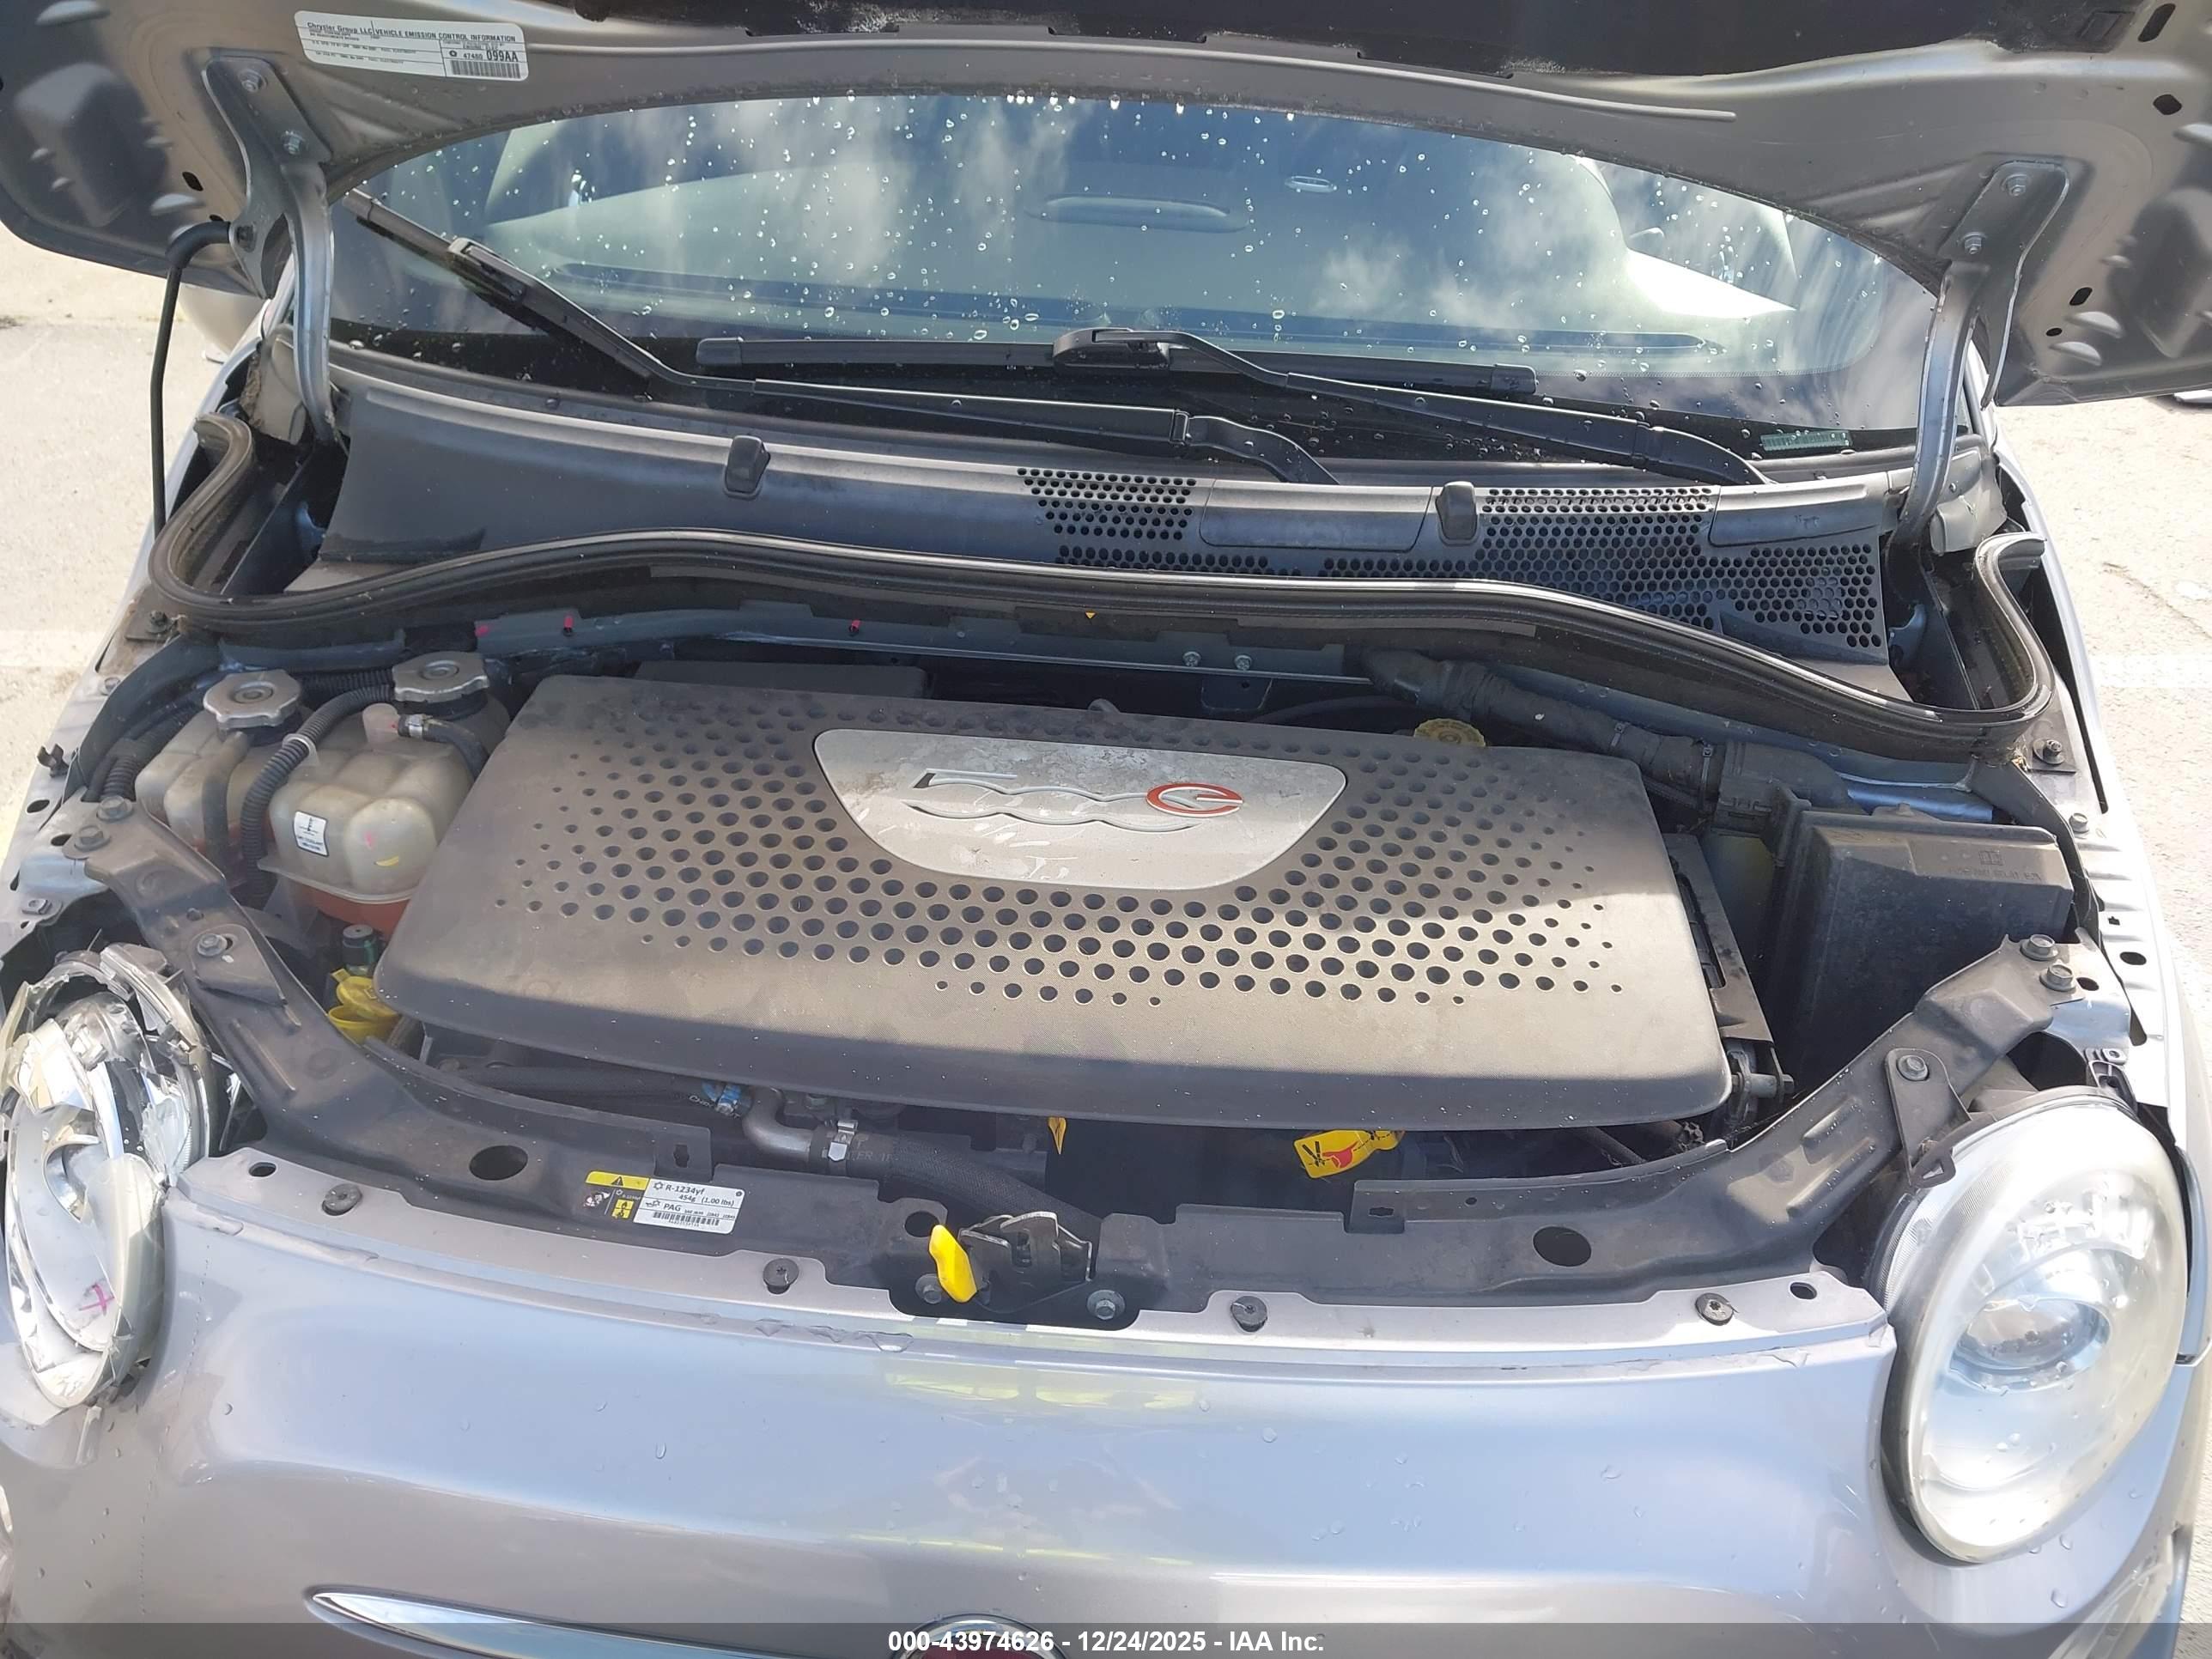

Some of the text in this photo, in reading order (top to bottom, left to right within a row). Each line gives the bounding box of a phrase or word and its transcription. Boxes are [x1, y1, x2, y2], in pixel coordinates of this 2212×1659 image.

[307, 21, 335, 32] Chrysler
[337, 24, 358, 34] Group
[359, 27, 372, 35] LLC
[375, 27, 403, 37] VEHICLE
[404, 30, 436, 40] EMISSION
[439, 33, 468, 41] CONTROL
[471, 34, 516, 43] INFORMATION
[486, 50, 519, 63] 099AA
[665, 1184, 706, 1196] R-1234yf
[678, 1194, 735, 1207] 454g (1.00 lbs)
[663, 1203, 681, 1212] PAG
